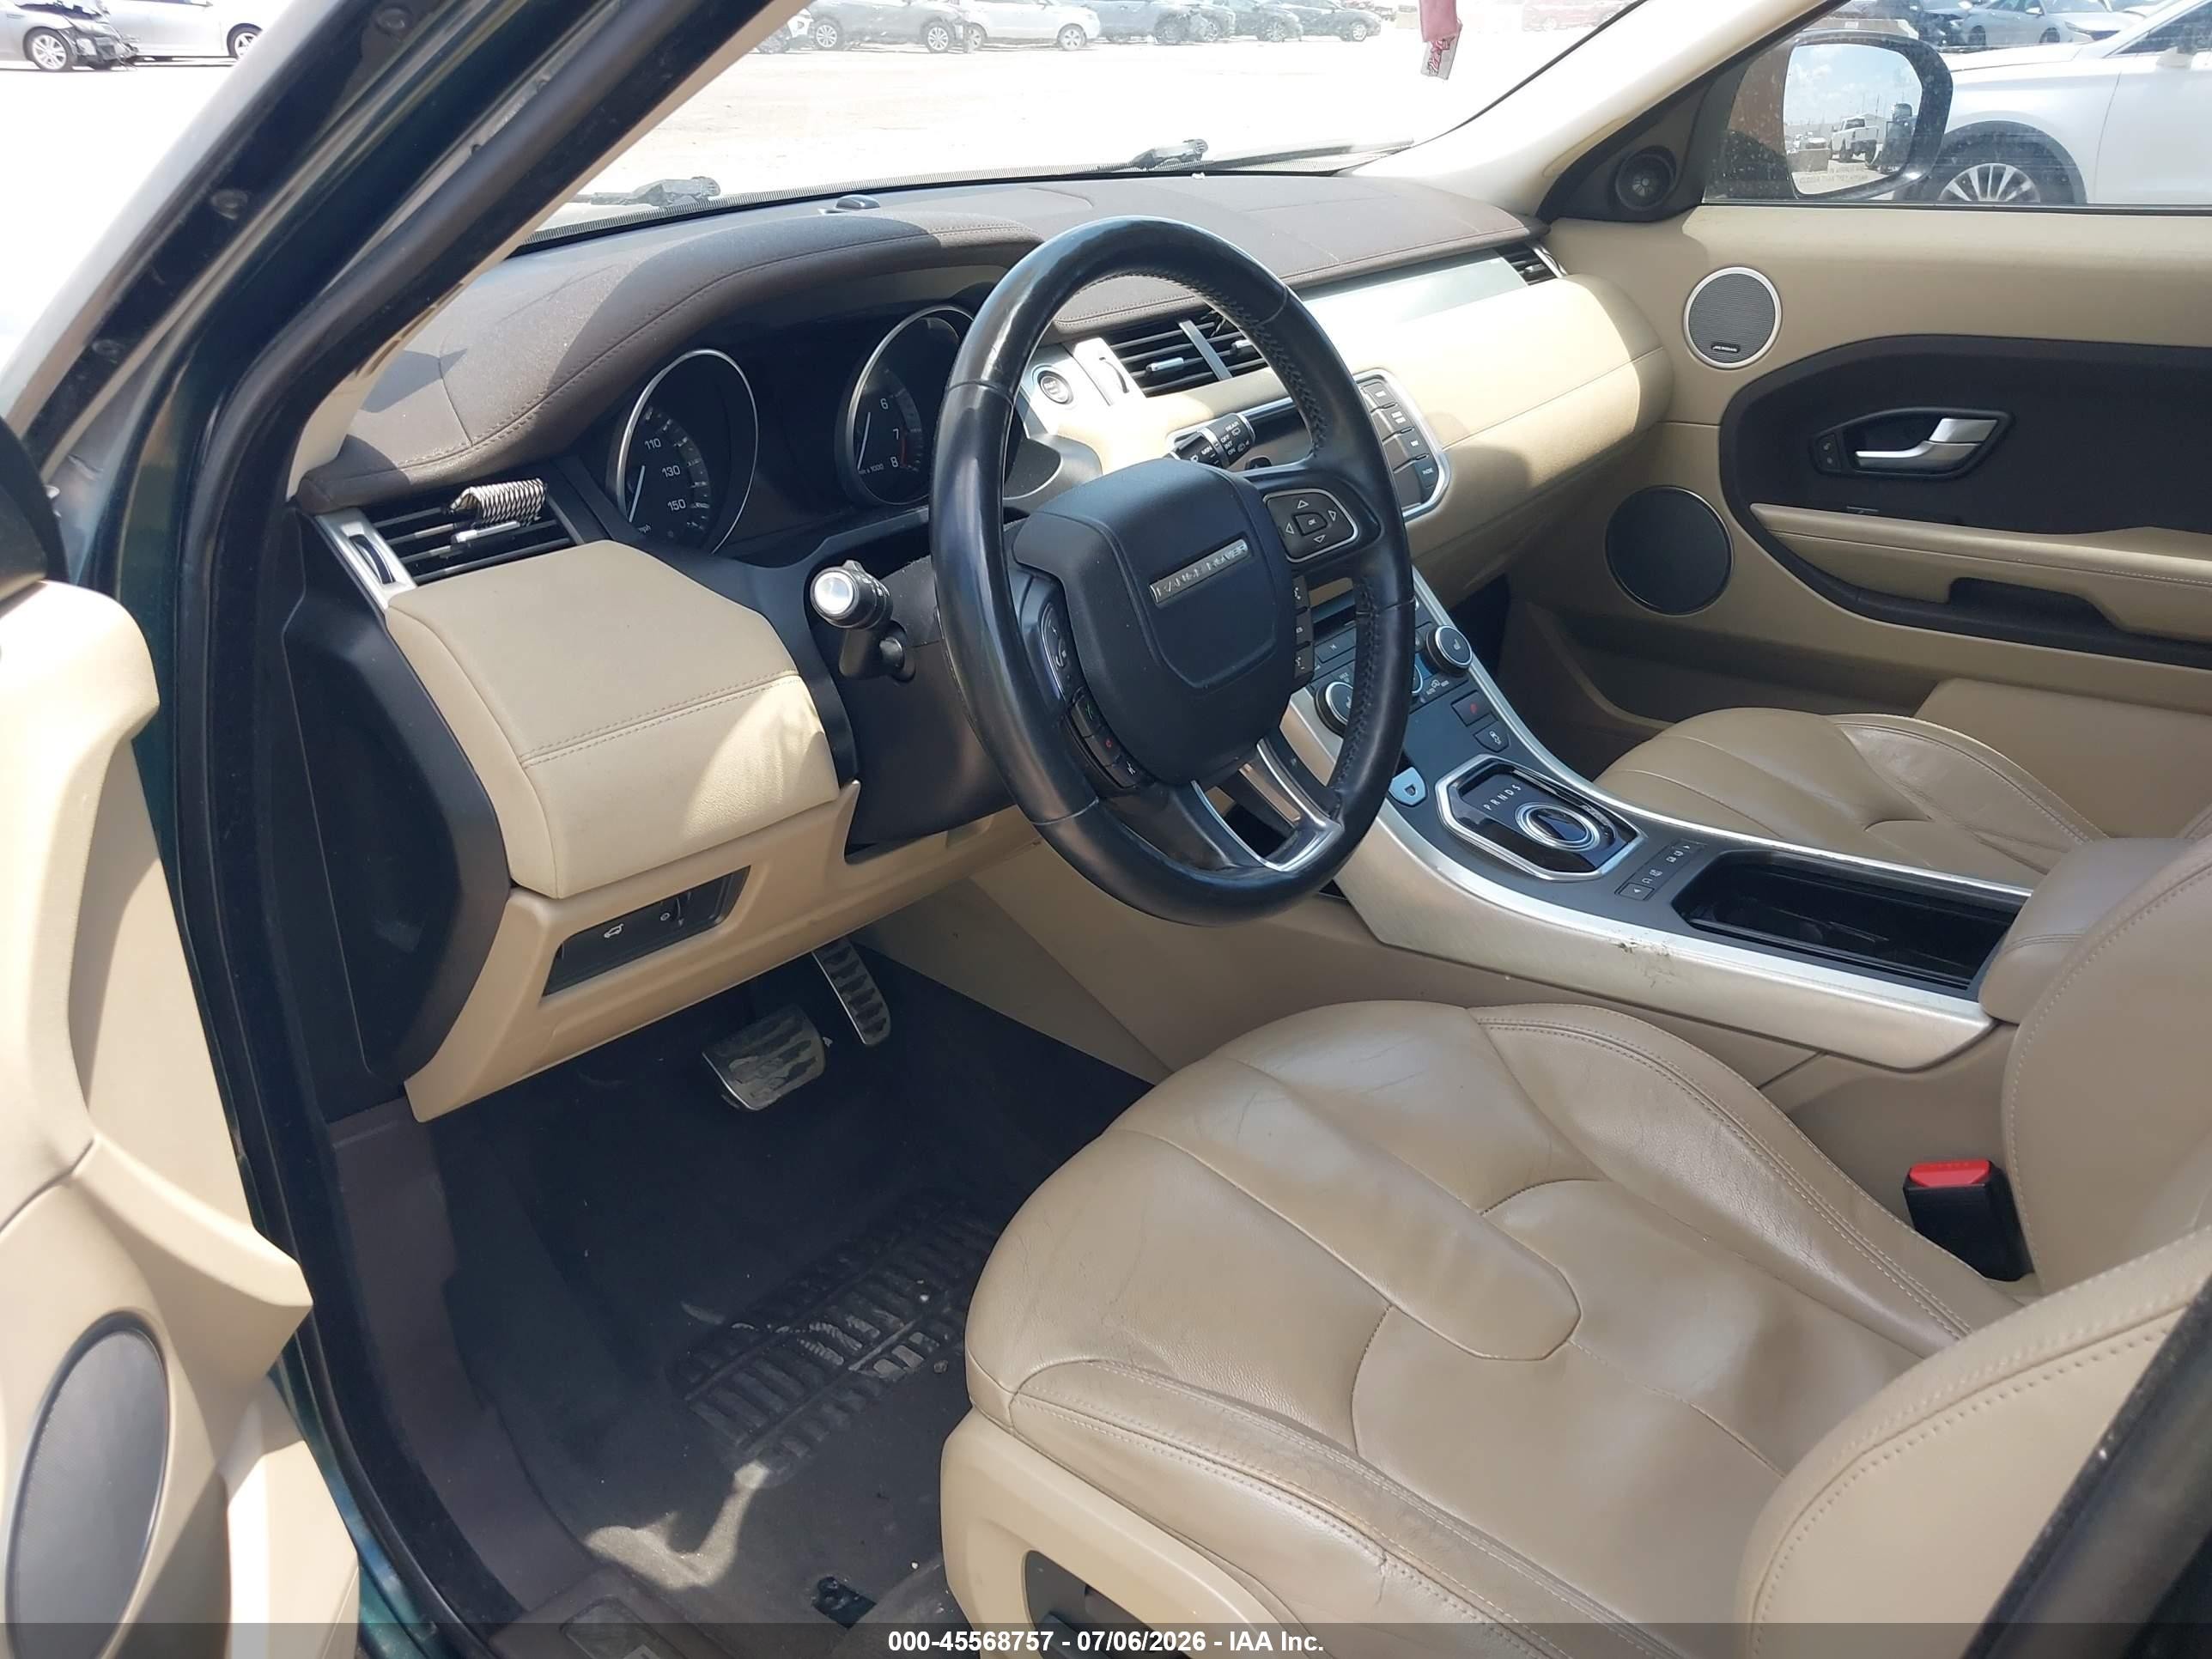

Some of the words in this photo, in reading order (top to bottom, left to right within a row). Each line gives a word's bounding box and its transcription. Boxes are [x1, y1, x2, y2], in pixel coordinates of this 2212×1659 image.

[880, 398, 889, 410] 6
[892, 428, 899, 441] 7
[1220, 434, 1231, 443] OFF
[644, 437, 662, 450] 110
[890, 456, 899, 468] 8
[661, 465, 681, 478] 130
[667, 499, 687, 512] 150
